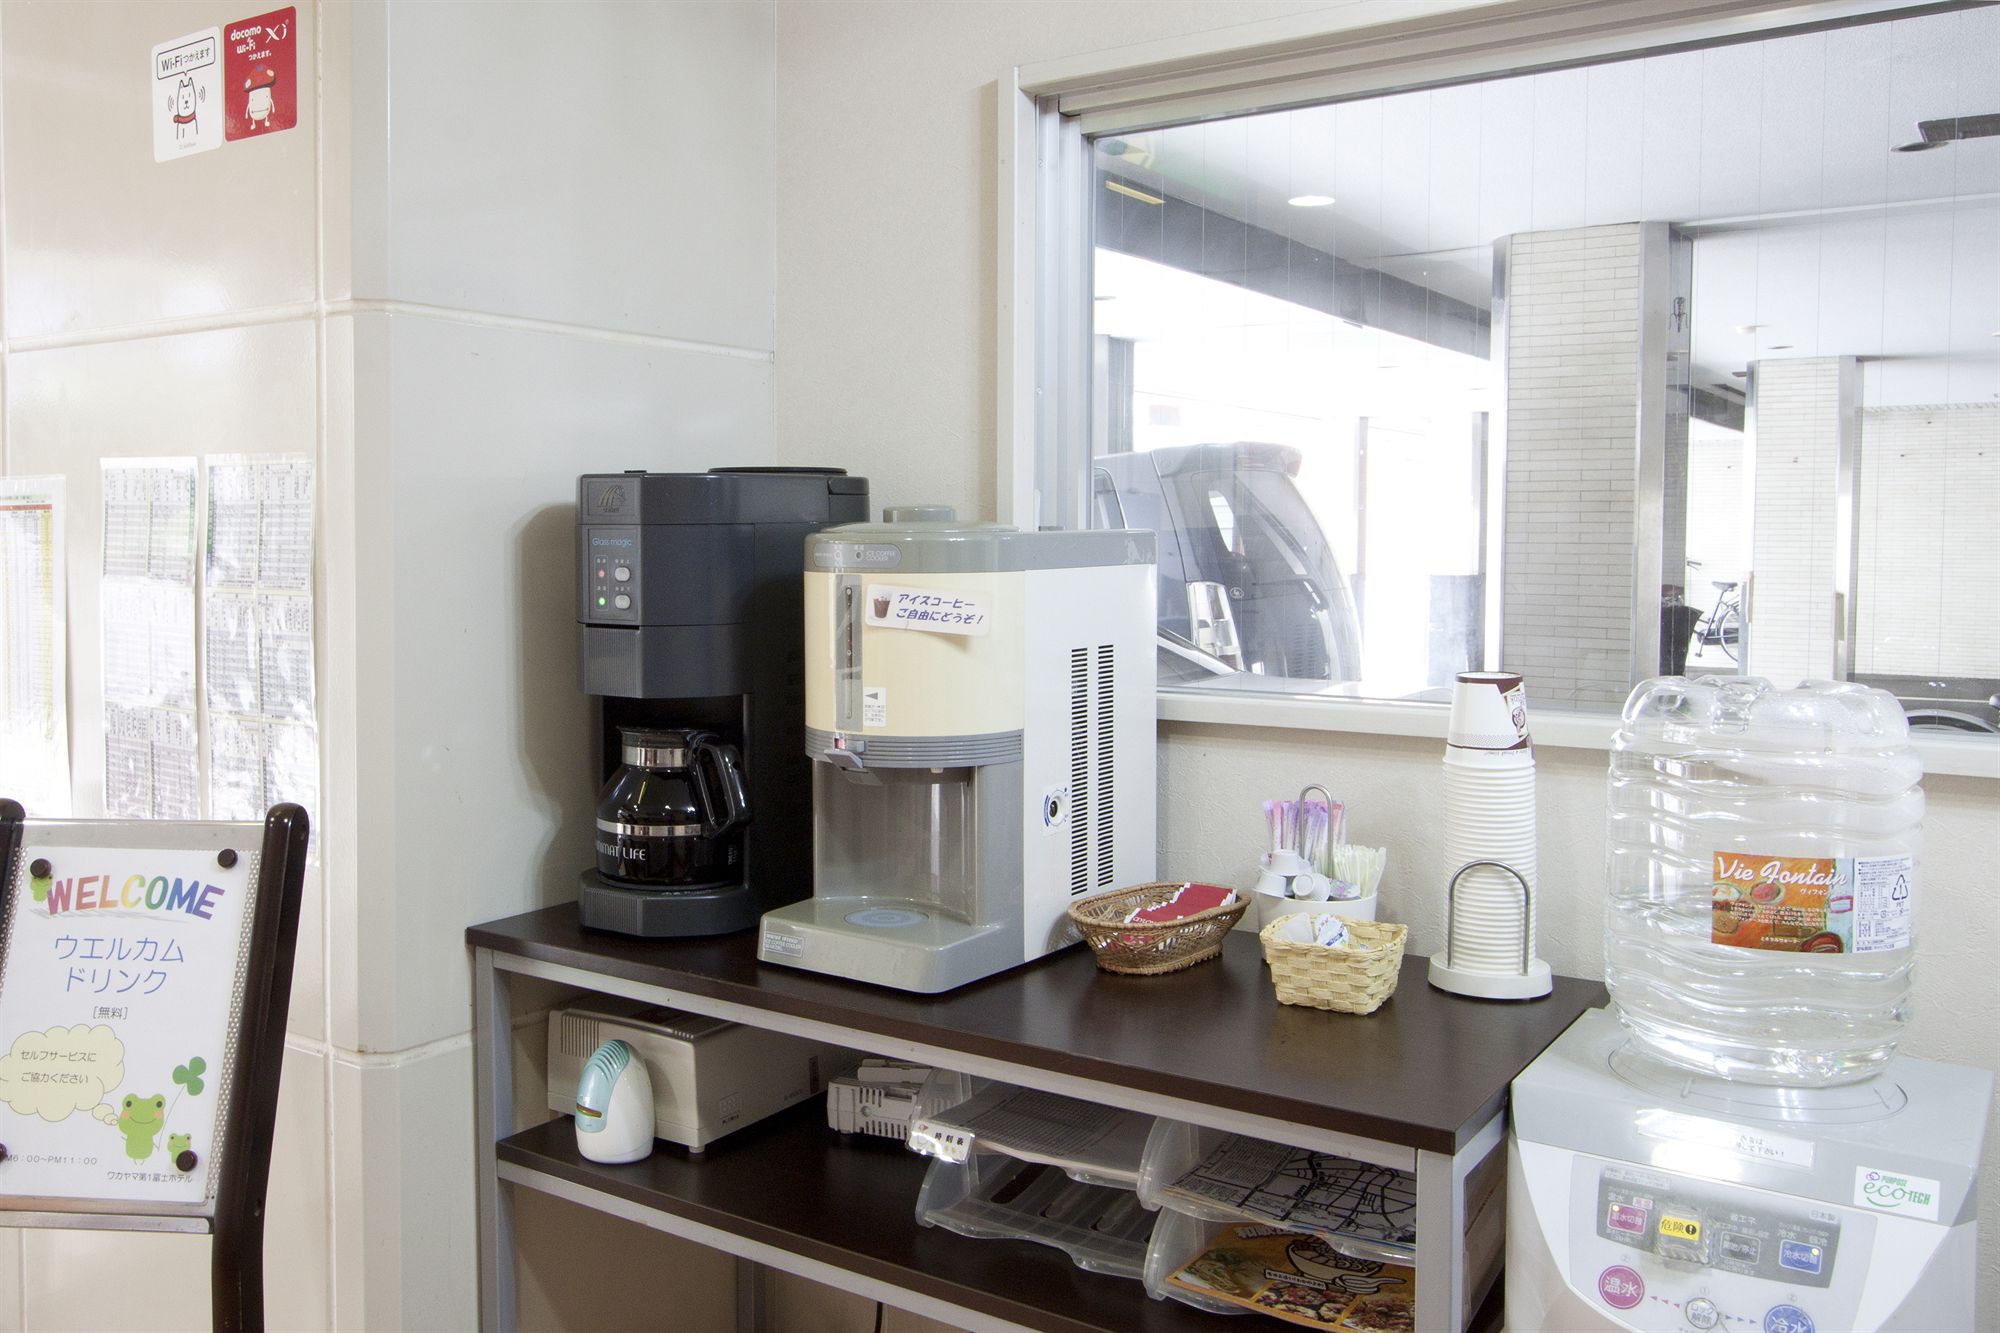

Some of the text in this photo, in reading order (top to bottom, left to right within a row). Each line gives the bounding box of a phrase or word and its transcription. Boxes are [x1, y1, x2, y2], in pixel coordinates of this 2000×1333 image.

[231, 25, 262, 41] docomo
[898, 593, 976, 609] アイスコーヒー
[622, 846, 647, 861] LIFE
[1717, 856, 1754, 881] Vie
[47, 874, 225, 920] WELCOME
[54, 934, 185, 963] ウエルカム
[66, 966, 168, 995] ドリンク
[20, 1049, 98, 1063] セルフサービスに
[20, 1071, 89, 1085] ご協力ください
[1603, 1275, 1639, 1298] 温水
